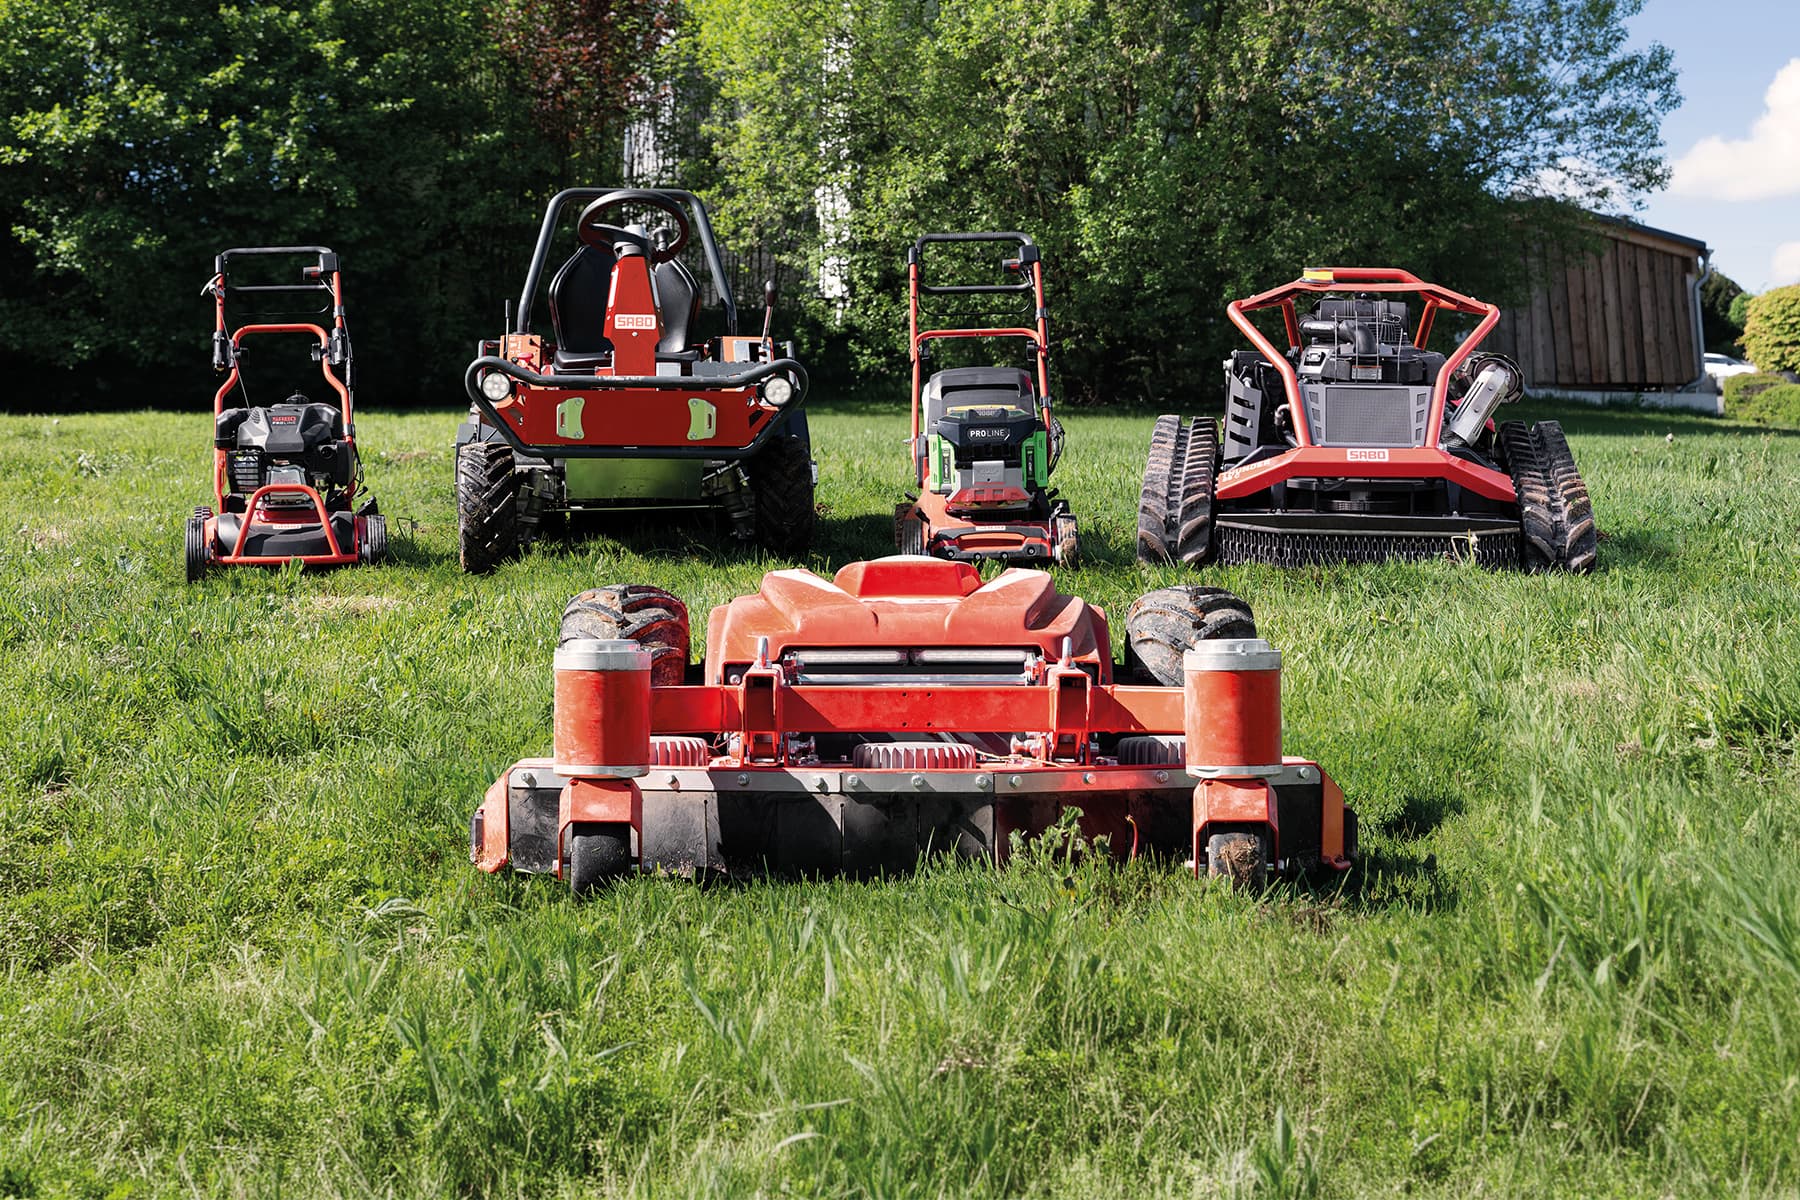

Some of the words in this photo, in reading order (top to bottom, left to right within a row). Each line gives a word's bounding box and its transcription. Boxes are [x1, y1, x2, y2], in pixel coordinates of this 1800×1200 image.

[617, 317, 653, 326] SABO
[970, 429, 1005, 437] PROLINE
[1349, 450, 1386, 459] SABO
